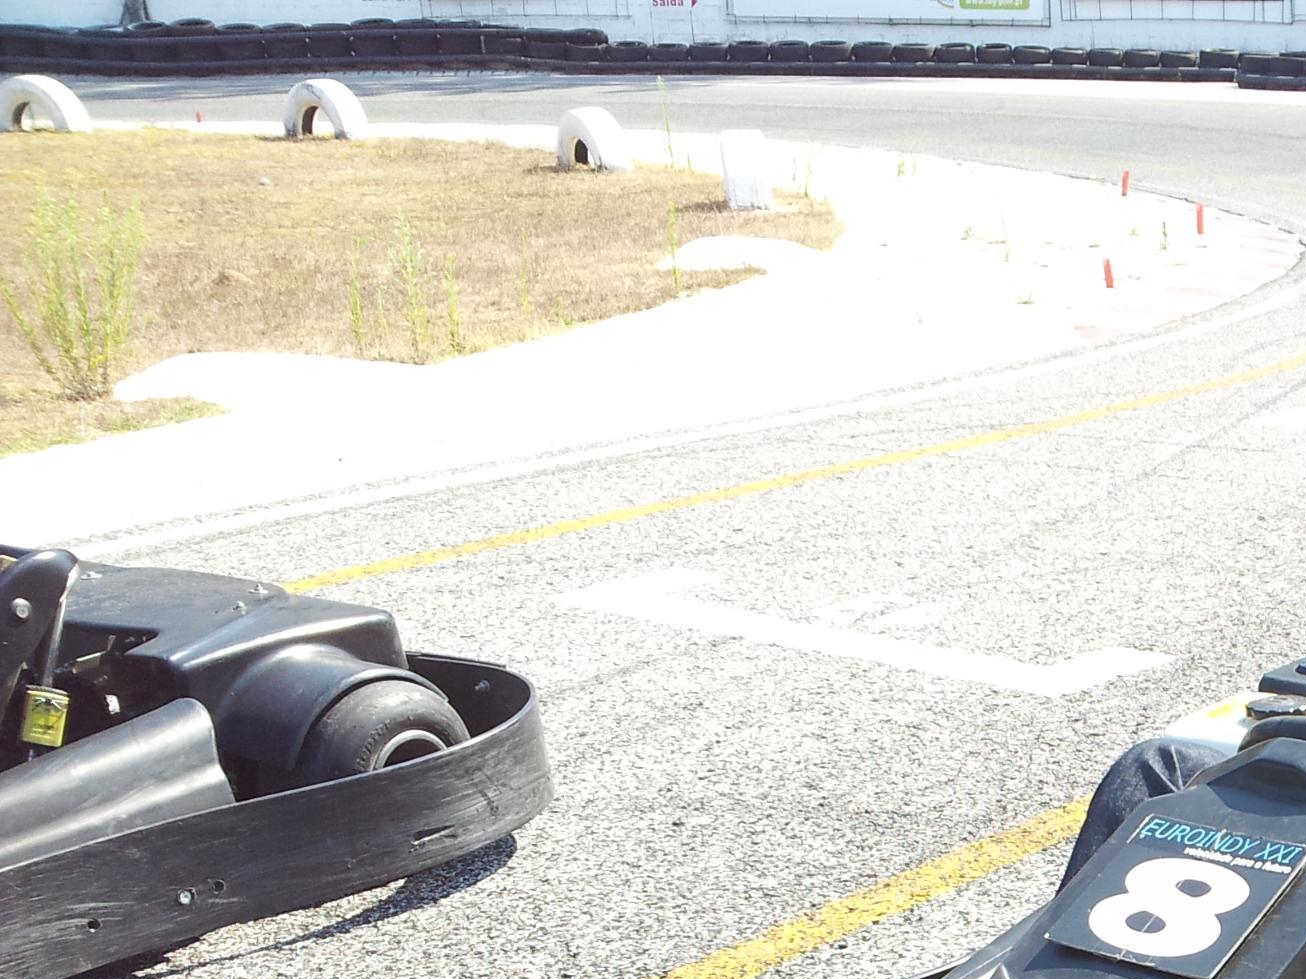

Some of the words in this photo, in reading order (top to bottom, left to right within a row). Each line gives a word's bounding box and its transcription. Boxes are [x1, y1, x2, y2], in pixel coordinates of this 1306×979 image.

[1141, 818, 1261, 855] EUROINDY
[1253, 842, 1302, 864] XXI
[1088, 857, 1250, 957] 8
